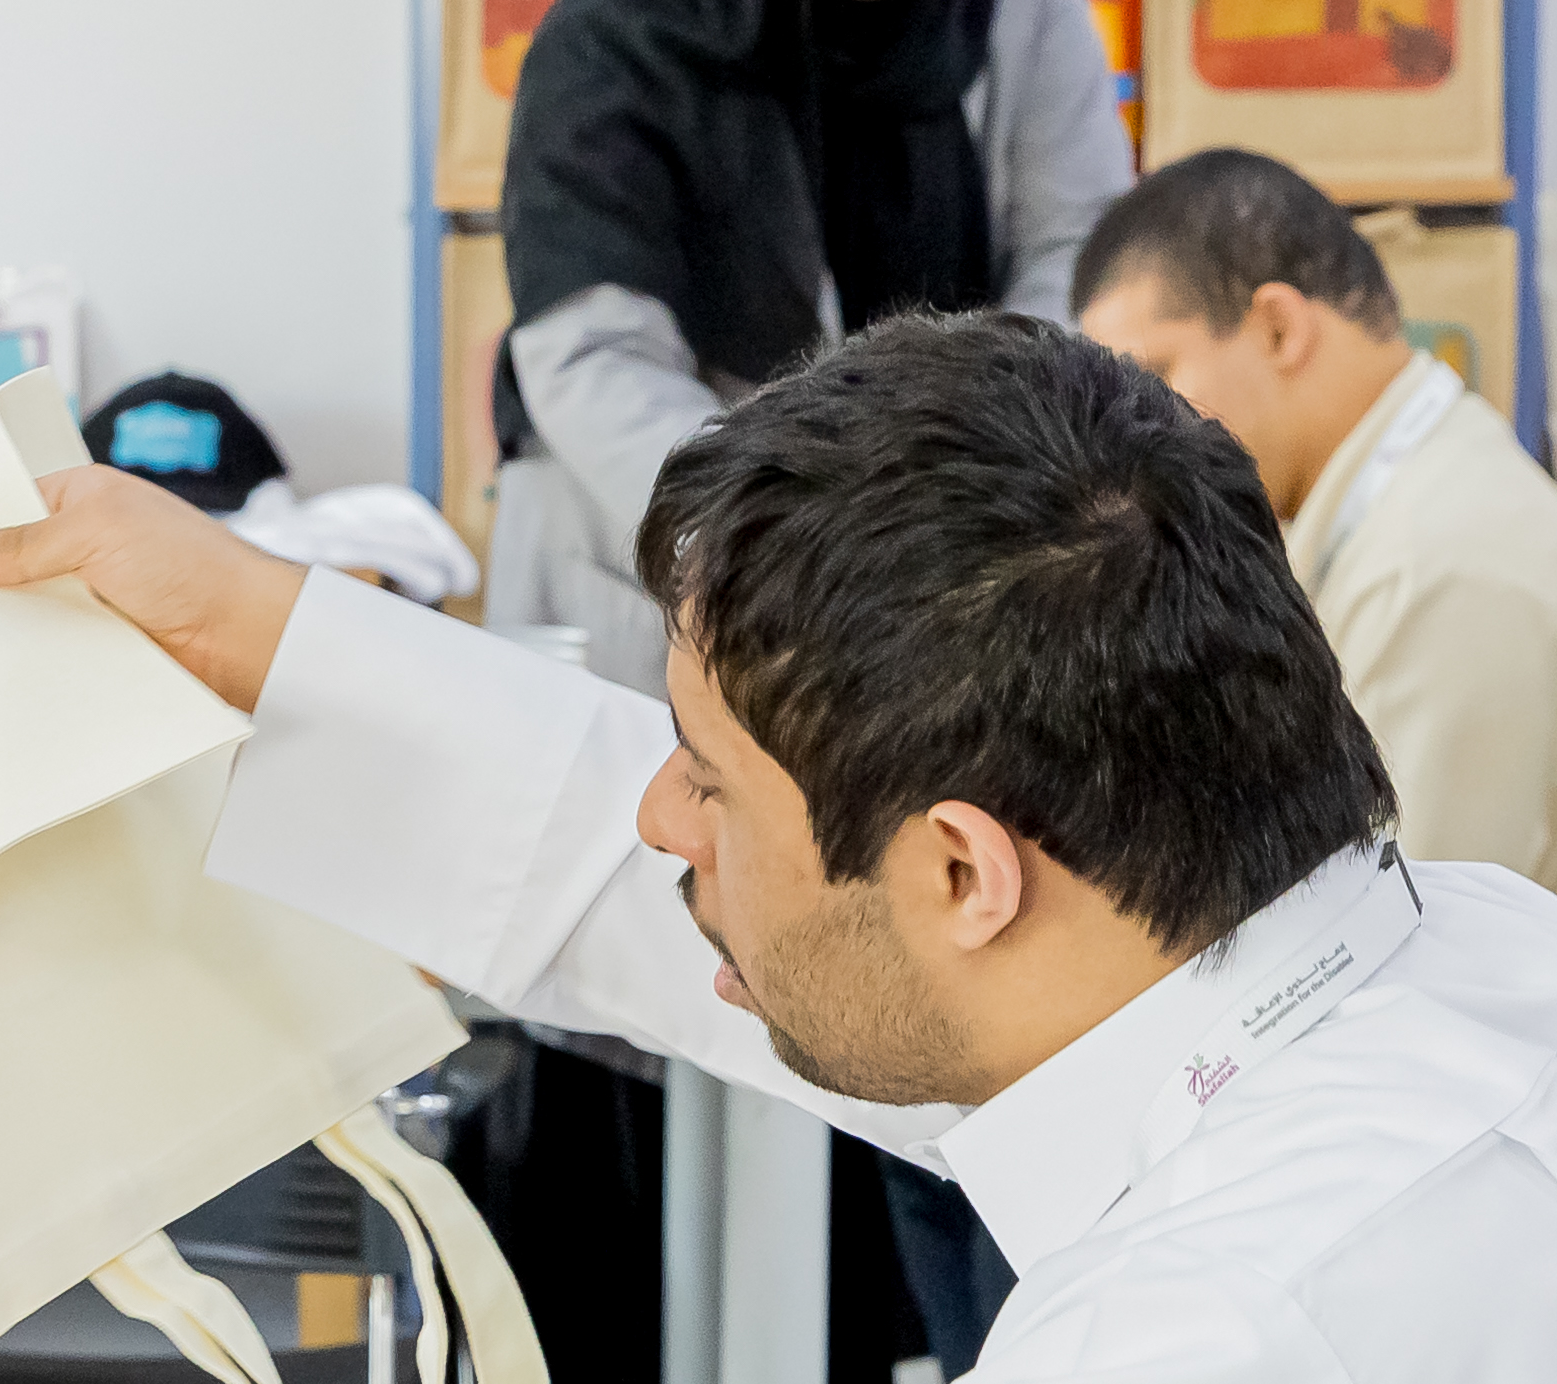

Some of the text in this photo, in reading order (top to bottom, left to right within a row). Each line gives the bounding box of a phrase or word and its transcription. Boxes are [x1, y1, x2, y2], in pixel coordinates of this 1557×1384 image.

[1251, 999, 1299, 1039] Integration
[1297, 988, 1312, 1003] for
[1310, 978, 1325, 993] the
